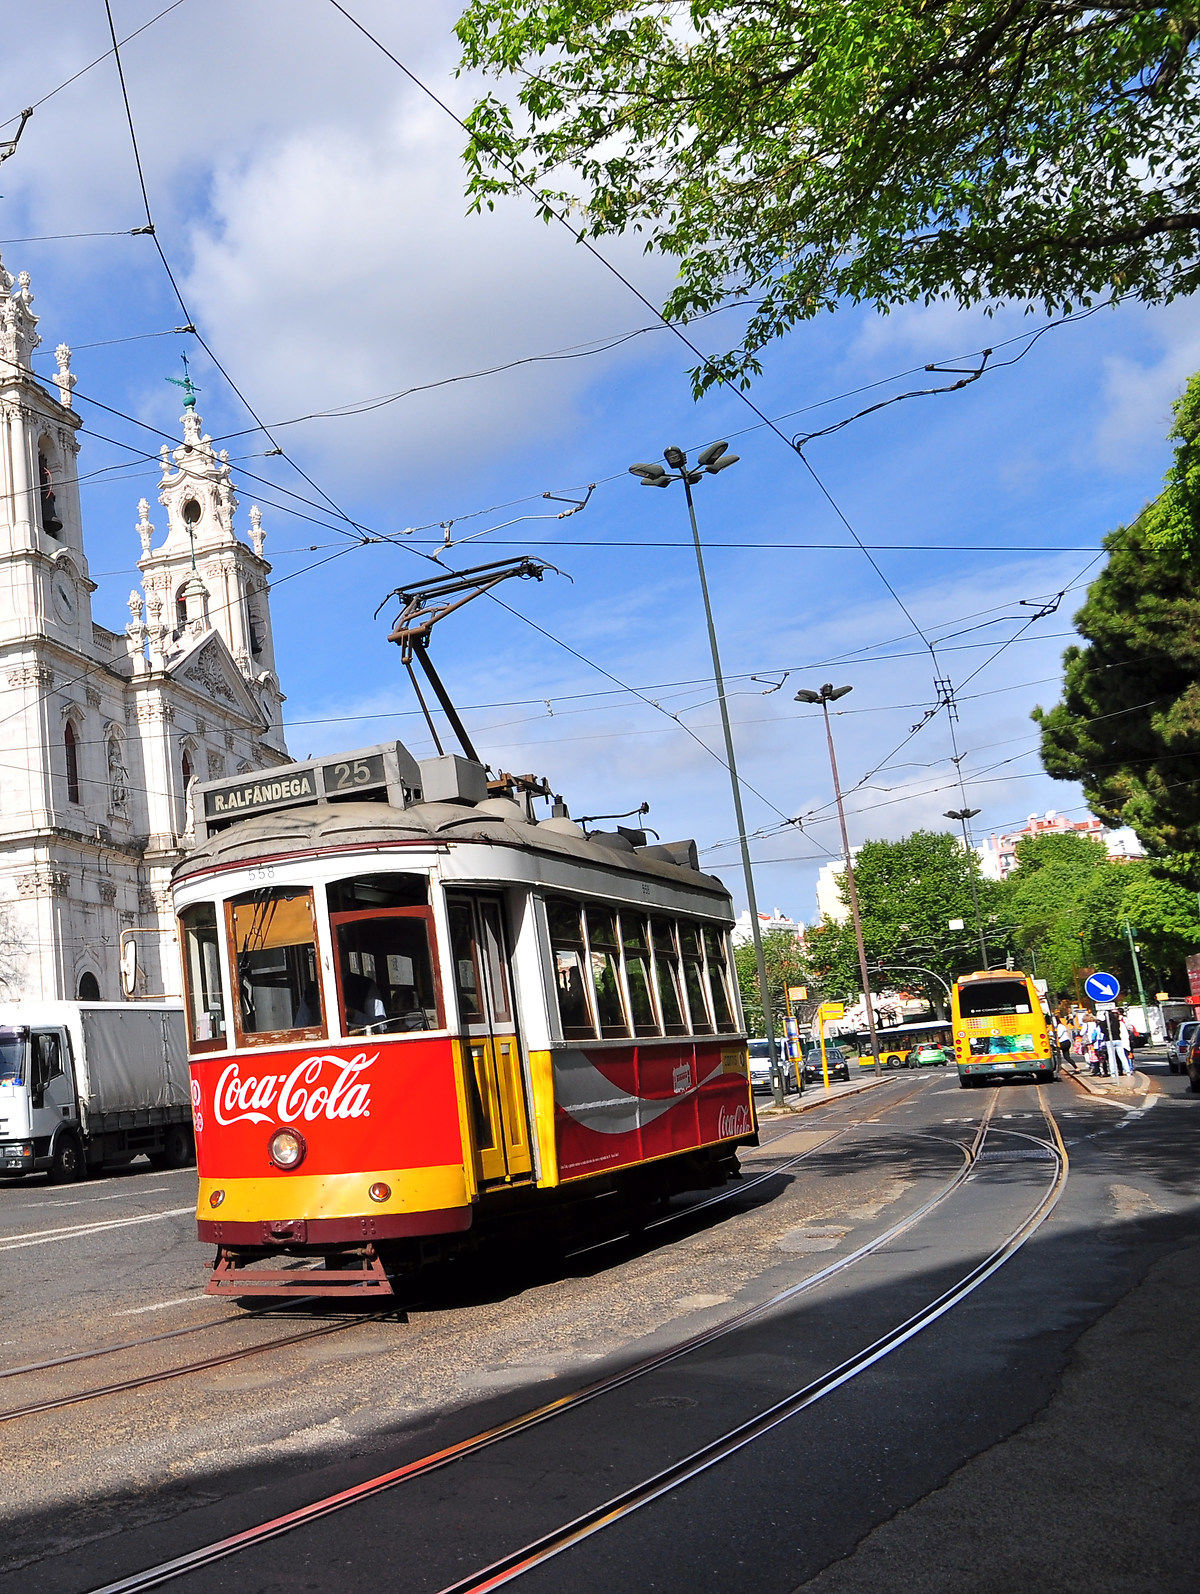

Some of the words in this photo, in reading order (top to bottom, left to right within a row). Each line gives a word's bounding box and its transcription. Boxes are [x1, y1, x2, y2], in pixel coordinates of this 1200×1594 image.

[334, 759, 372, 789] 25
[214, 777, 312, 811] R.ALFÂNDEGA
[248, 866, 275, 880] 558
[214, 1051, 381, 1126] Coca-Cola
